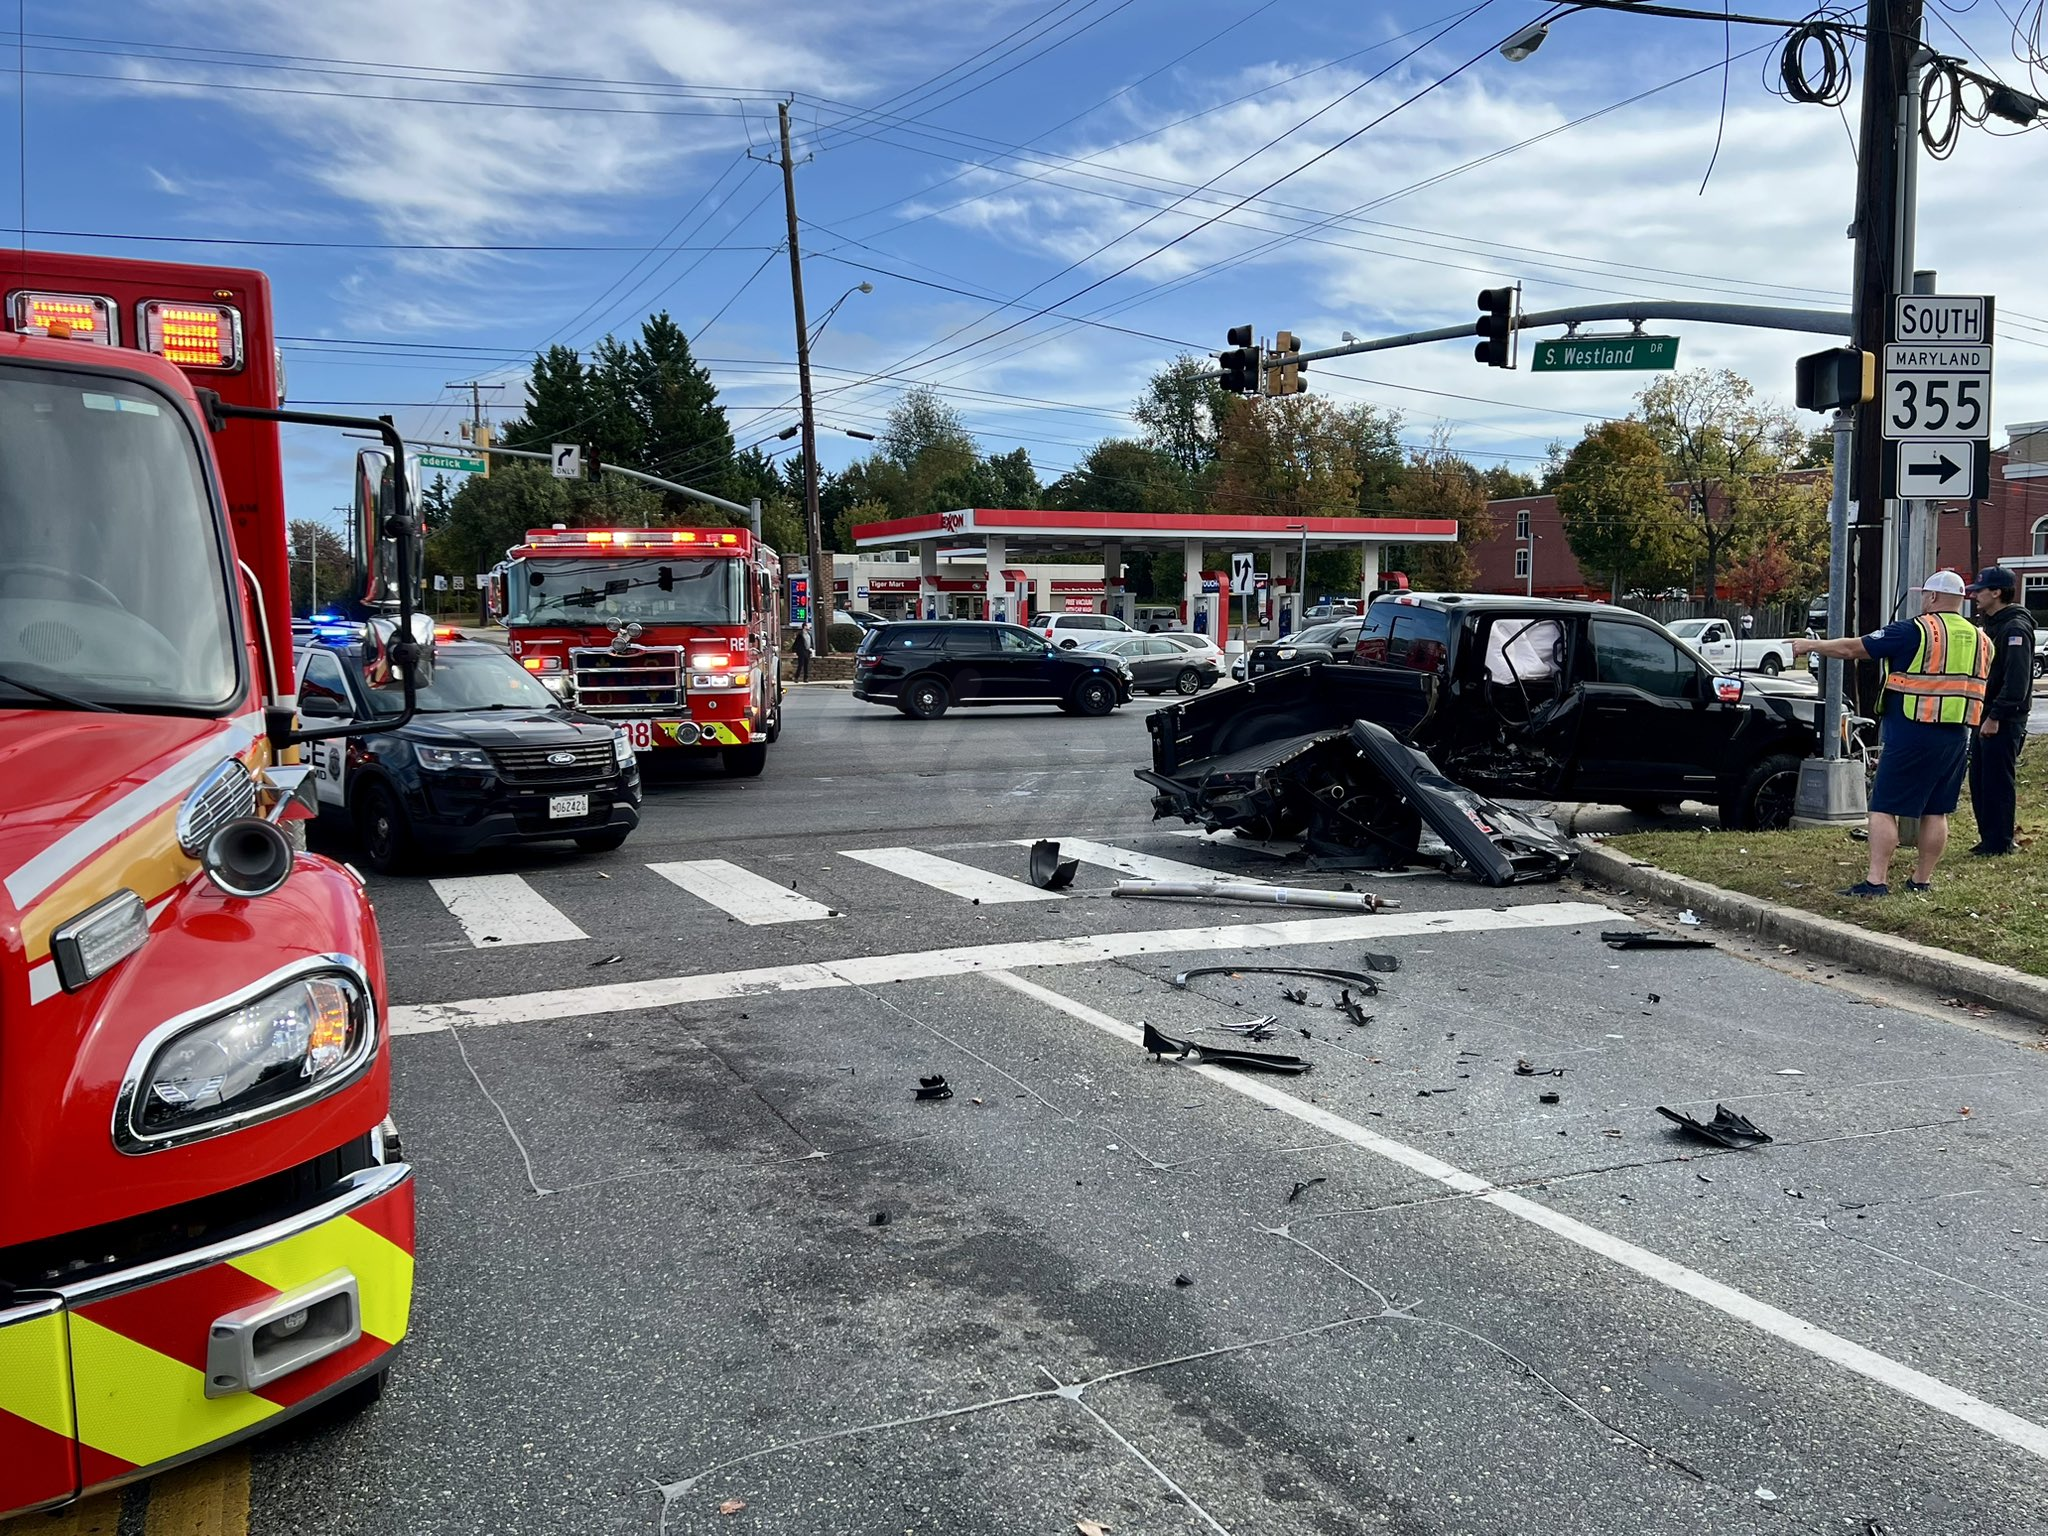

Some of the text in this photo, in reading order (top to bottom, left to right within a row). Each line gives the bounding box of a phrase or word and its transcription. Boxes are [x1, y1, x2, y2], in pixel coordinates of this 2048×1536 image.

[1902, 304, 1978, 334] SOUTH
[1545, 343, 1663, 365] S. Westland DR
[1896, 352, 1980, 366] MARYLAND
[1892, 380, 1981, 430] 355
[419, 456, 461, 469] rederick
[557, 467, 576, 476] ONLY
[871, 580, 888, 588] Tiger
[1929, 620, 1940, 643] FIRE
